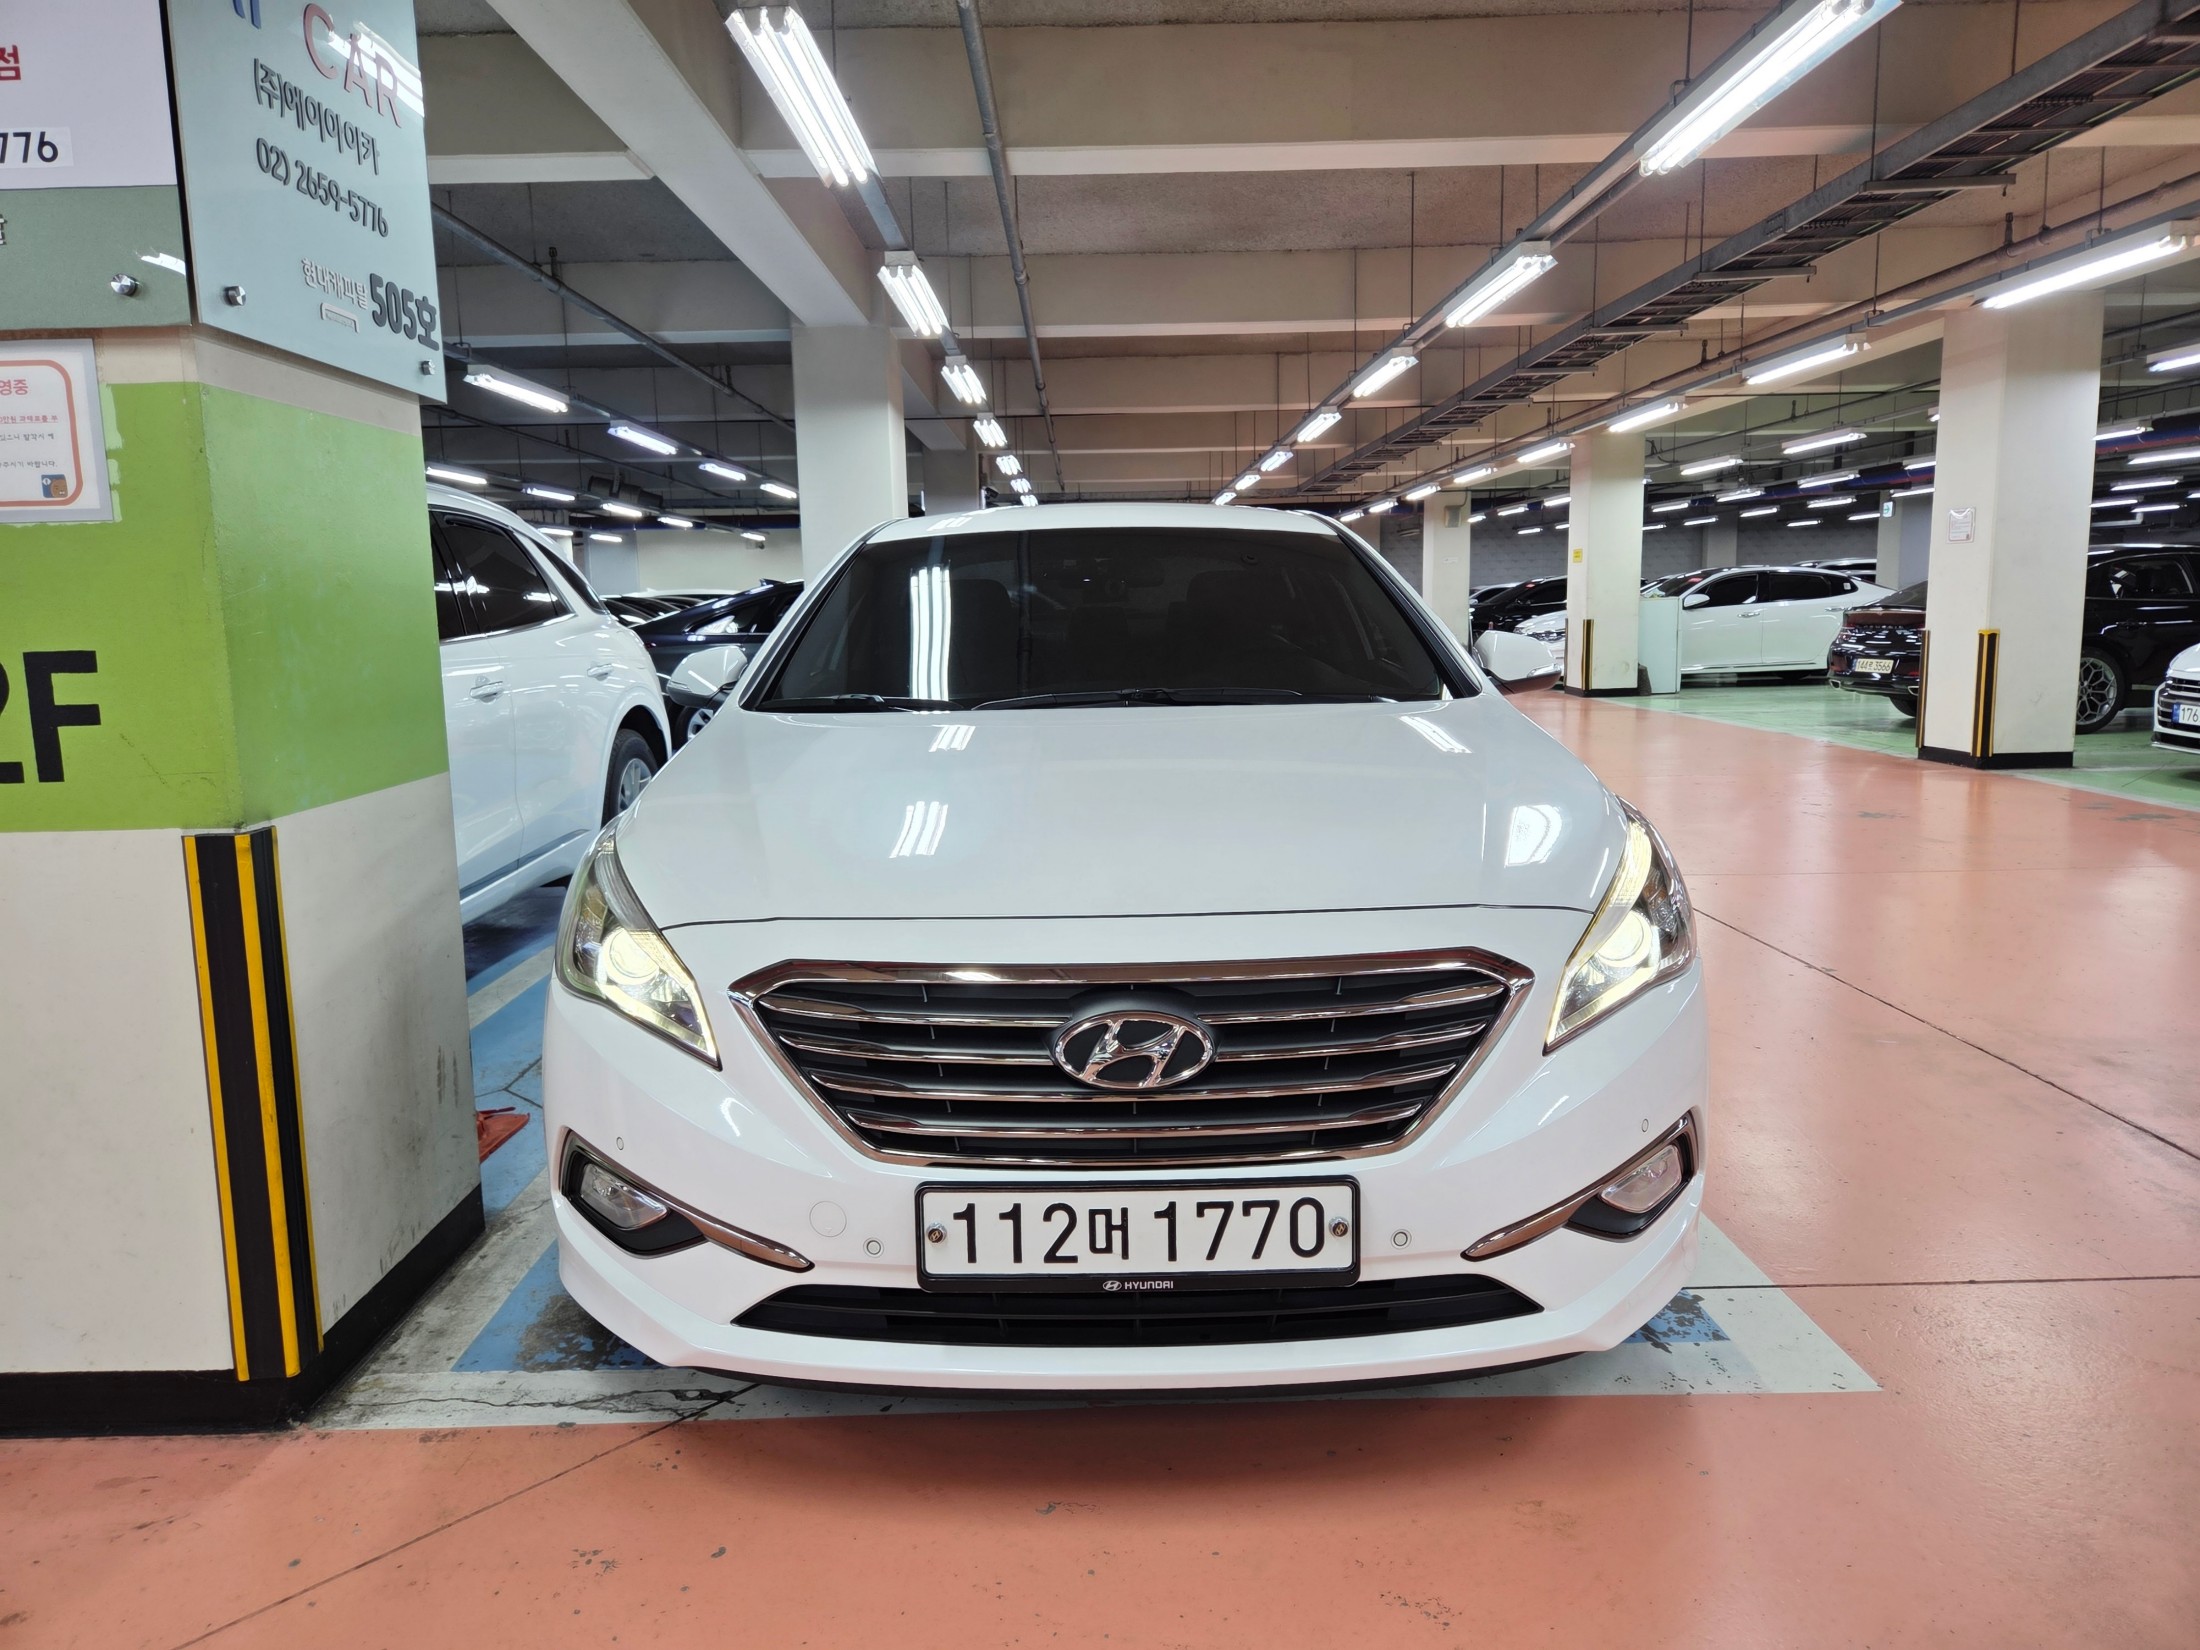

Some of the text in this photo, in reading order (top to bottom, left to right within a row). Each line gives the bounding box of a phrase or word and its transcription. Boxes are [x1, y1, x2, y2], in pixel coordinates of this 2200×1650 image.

[303, 3, 402, 129] CAR
[295, 160, 388, 238] 2659-5776
[301, 258, 440, 352] 현대캐피탈 505호
[1124, 1280, 1174, 1290] HYUNDAI
